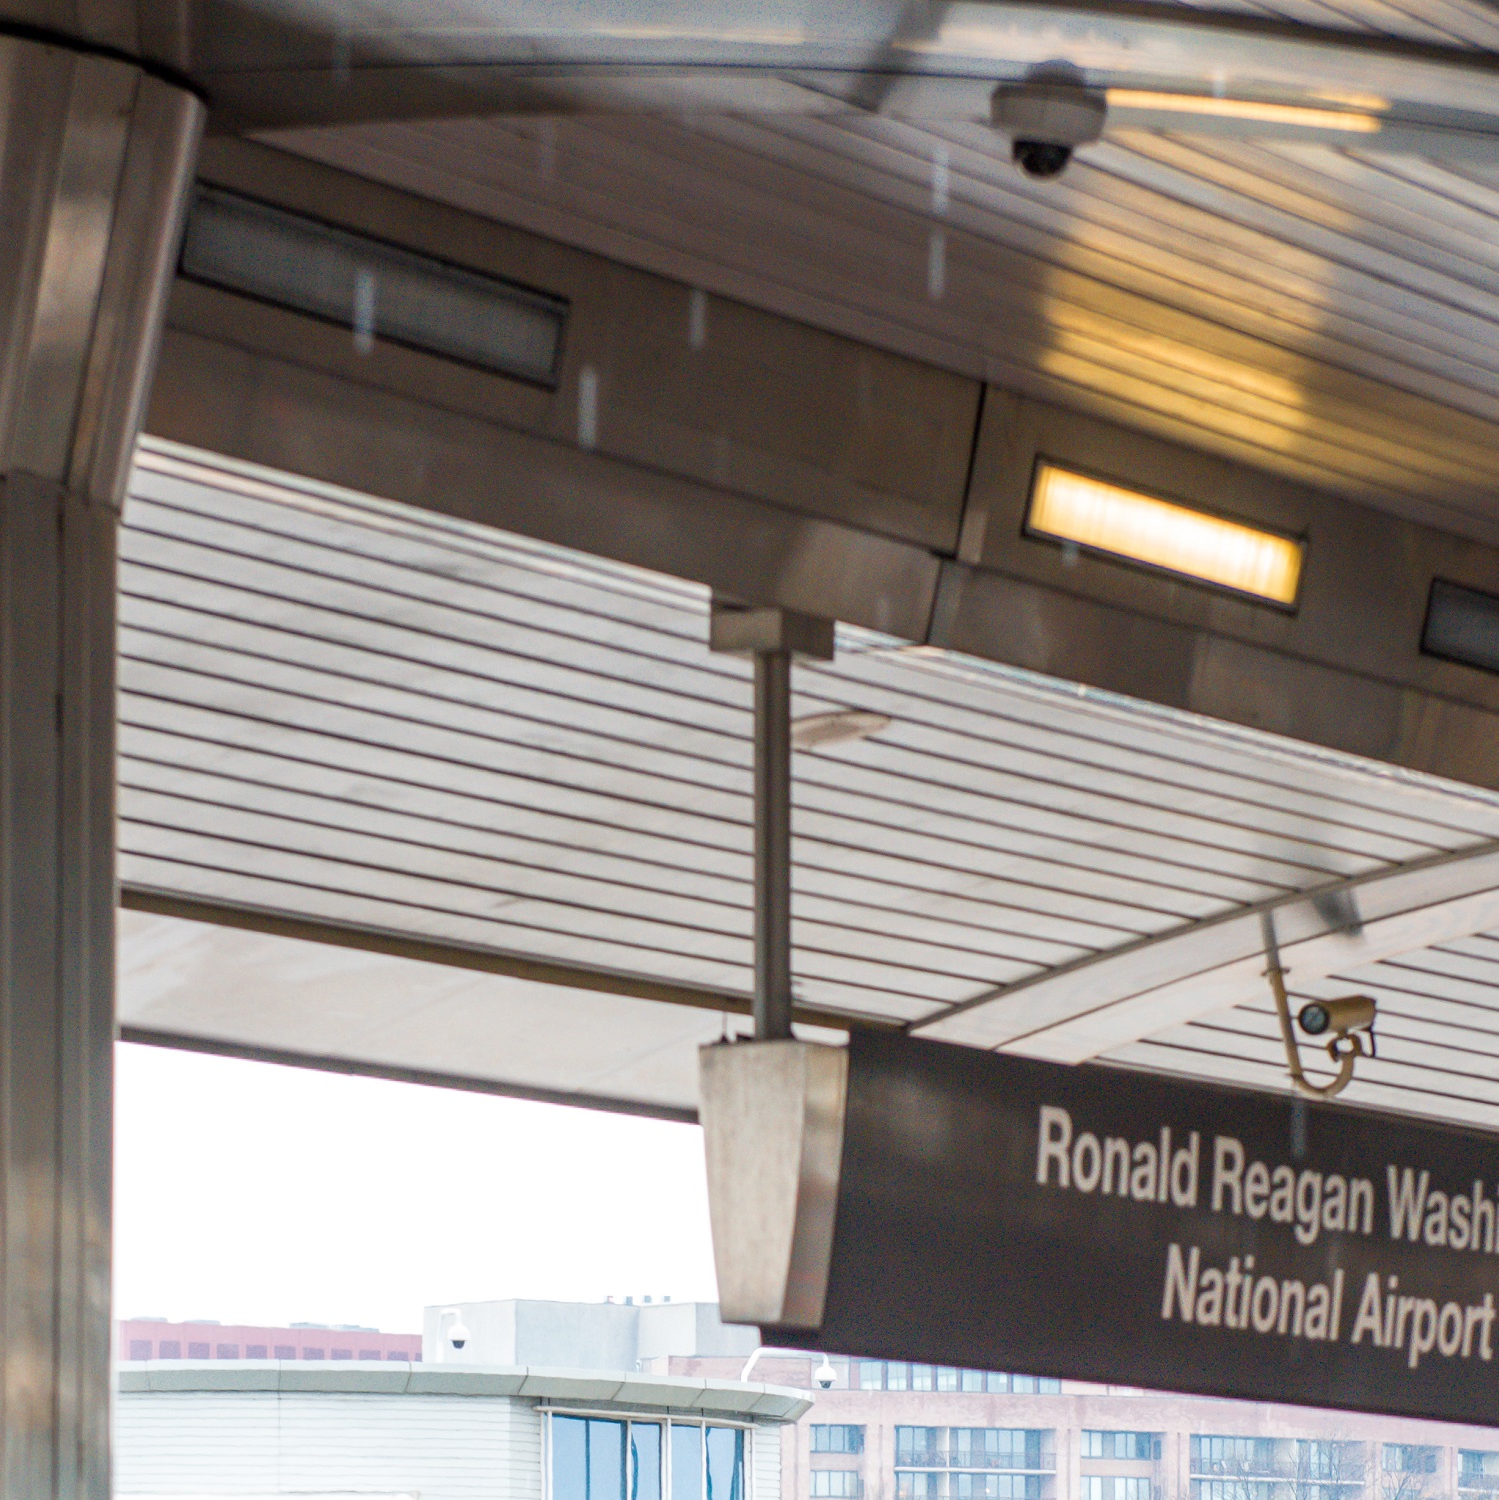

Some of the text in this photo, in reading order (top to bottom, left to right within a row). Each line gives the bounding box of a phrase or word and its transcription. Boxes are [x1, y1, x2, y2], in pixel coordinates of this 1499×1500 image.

[1036, 1105, 1201, 1208] Ronald
[1211, 1134, 1375, 1246] Reagan
[1160, 1243, 1496, 1369] National Airport
